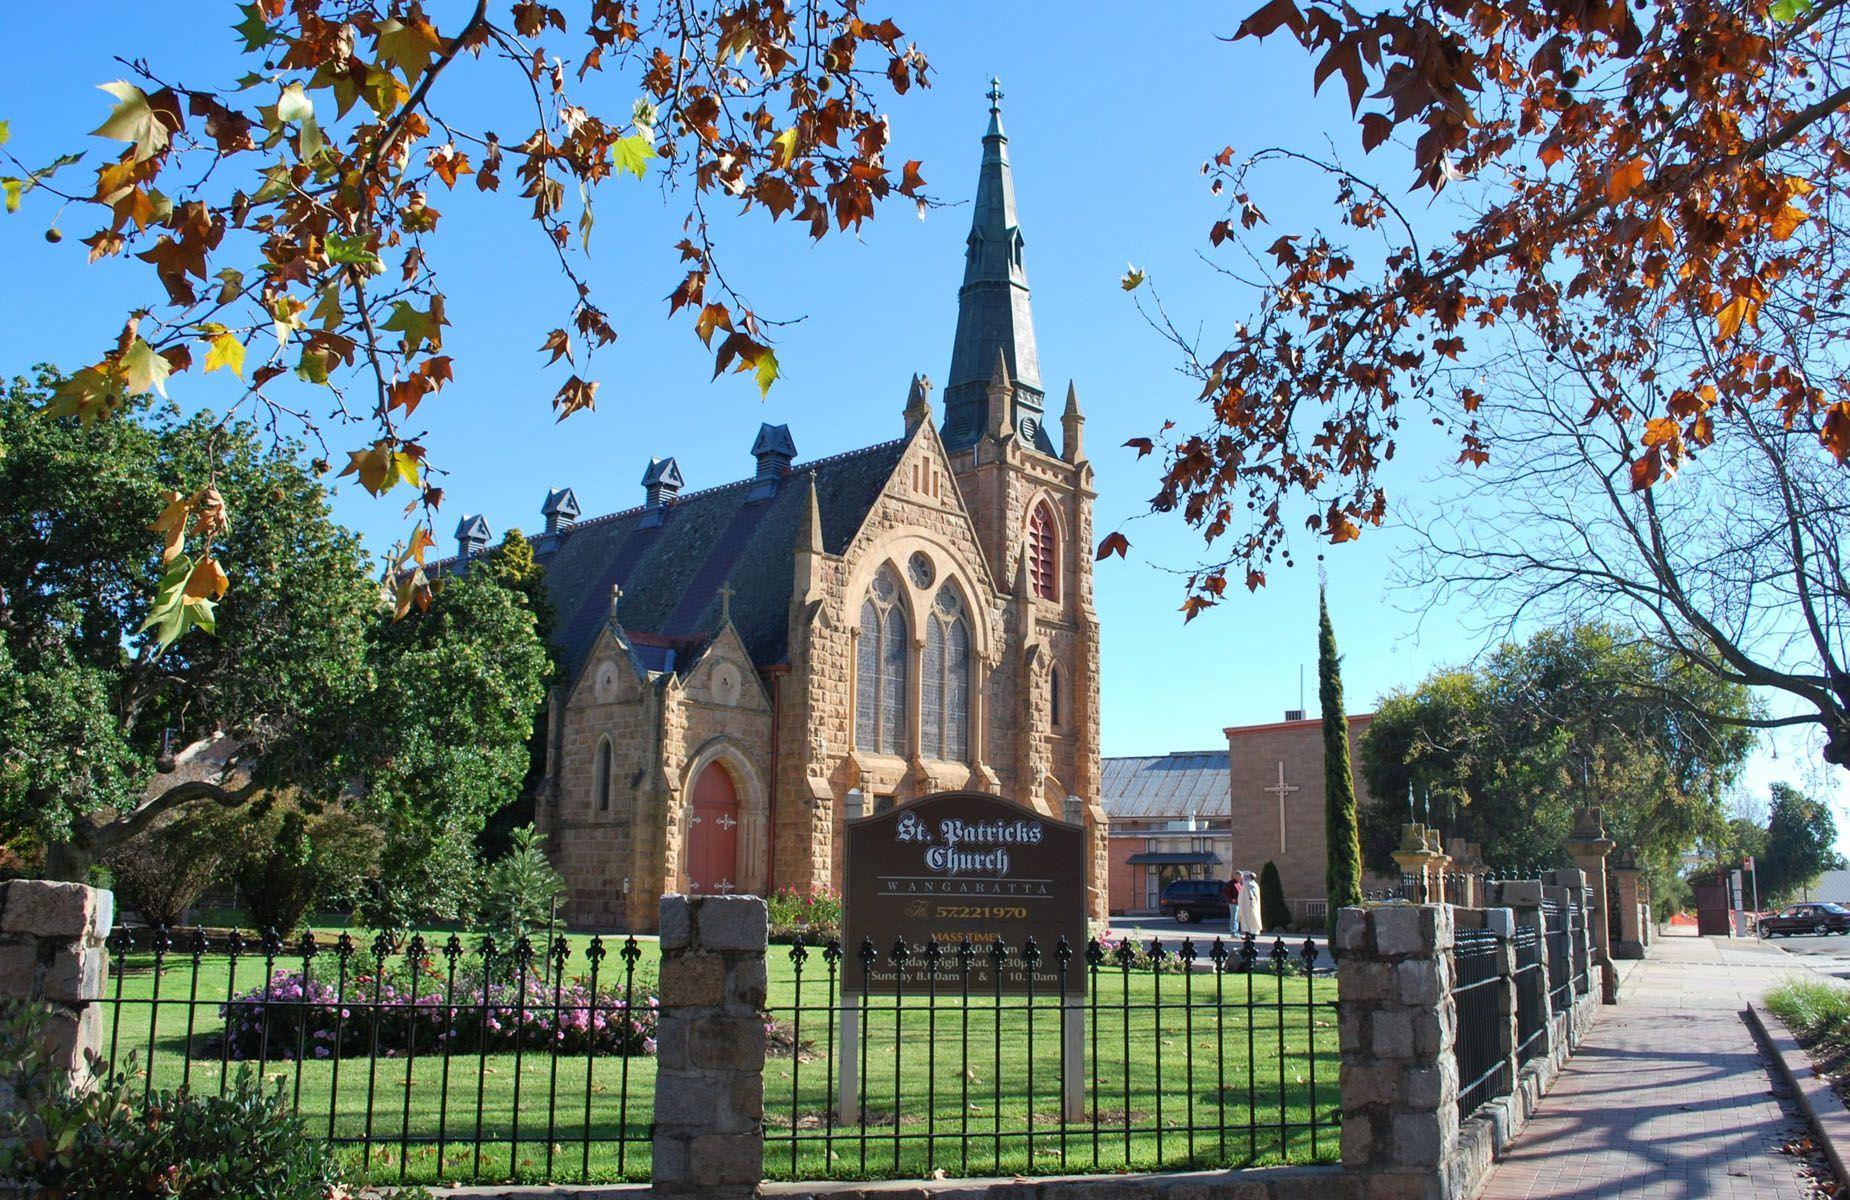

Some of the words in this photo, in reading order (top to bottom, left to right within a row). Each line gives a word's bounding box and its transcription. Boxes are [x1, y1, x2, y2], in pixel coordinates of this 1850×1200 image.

[896, 811, 932, 843] St.
[940, 819, 1043, 848] Patricks
[924, 847, 1010, 877] Church
[887, 881, 1047, 895] WANGARATTA
[969, 932, 1000, 943] TIME
[888, 957, 929, 969] Sday
[932, 957, 959, 969] igil
[978, 971, 988, 981] &
[1009, 972, 1058, 981] 10.0am
